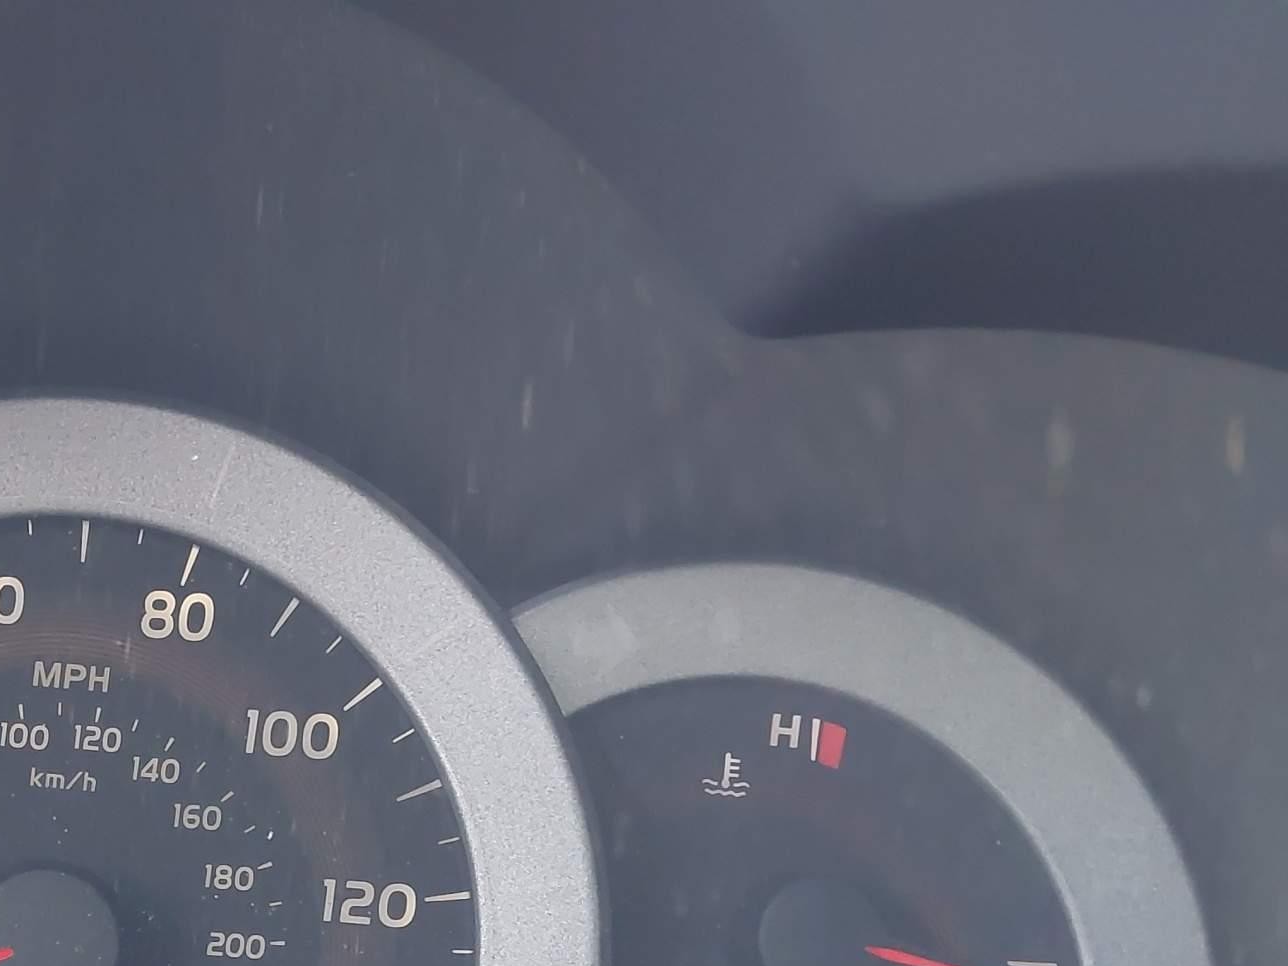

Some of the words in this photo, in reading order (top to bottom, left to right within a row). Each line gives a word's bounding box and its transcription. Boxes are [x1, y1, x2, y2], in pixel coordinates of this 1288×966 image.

[141, 591, 214, 641] 80
[33, 661, 110, 692] MPH
[1, 723, 49, 750] 100
[75, 725, 121, 752] 120
[246, 710, 338, 759] 100
[770, 714, 801, 748] H
[30, 768, 96, 792] km/h
[133, 757, 179, 783] 140
[174, 804, 221, 830] 160
[205, 865, 253, 890] 180
[324, 879, 416, 927] 120
[207, 932, 265, 959] 200
